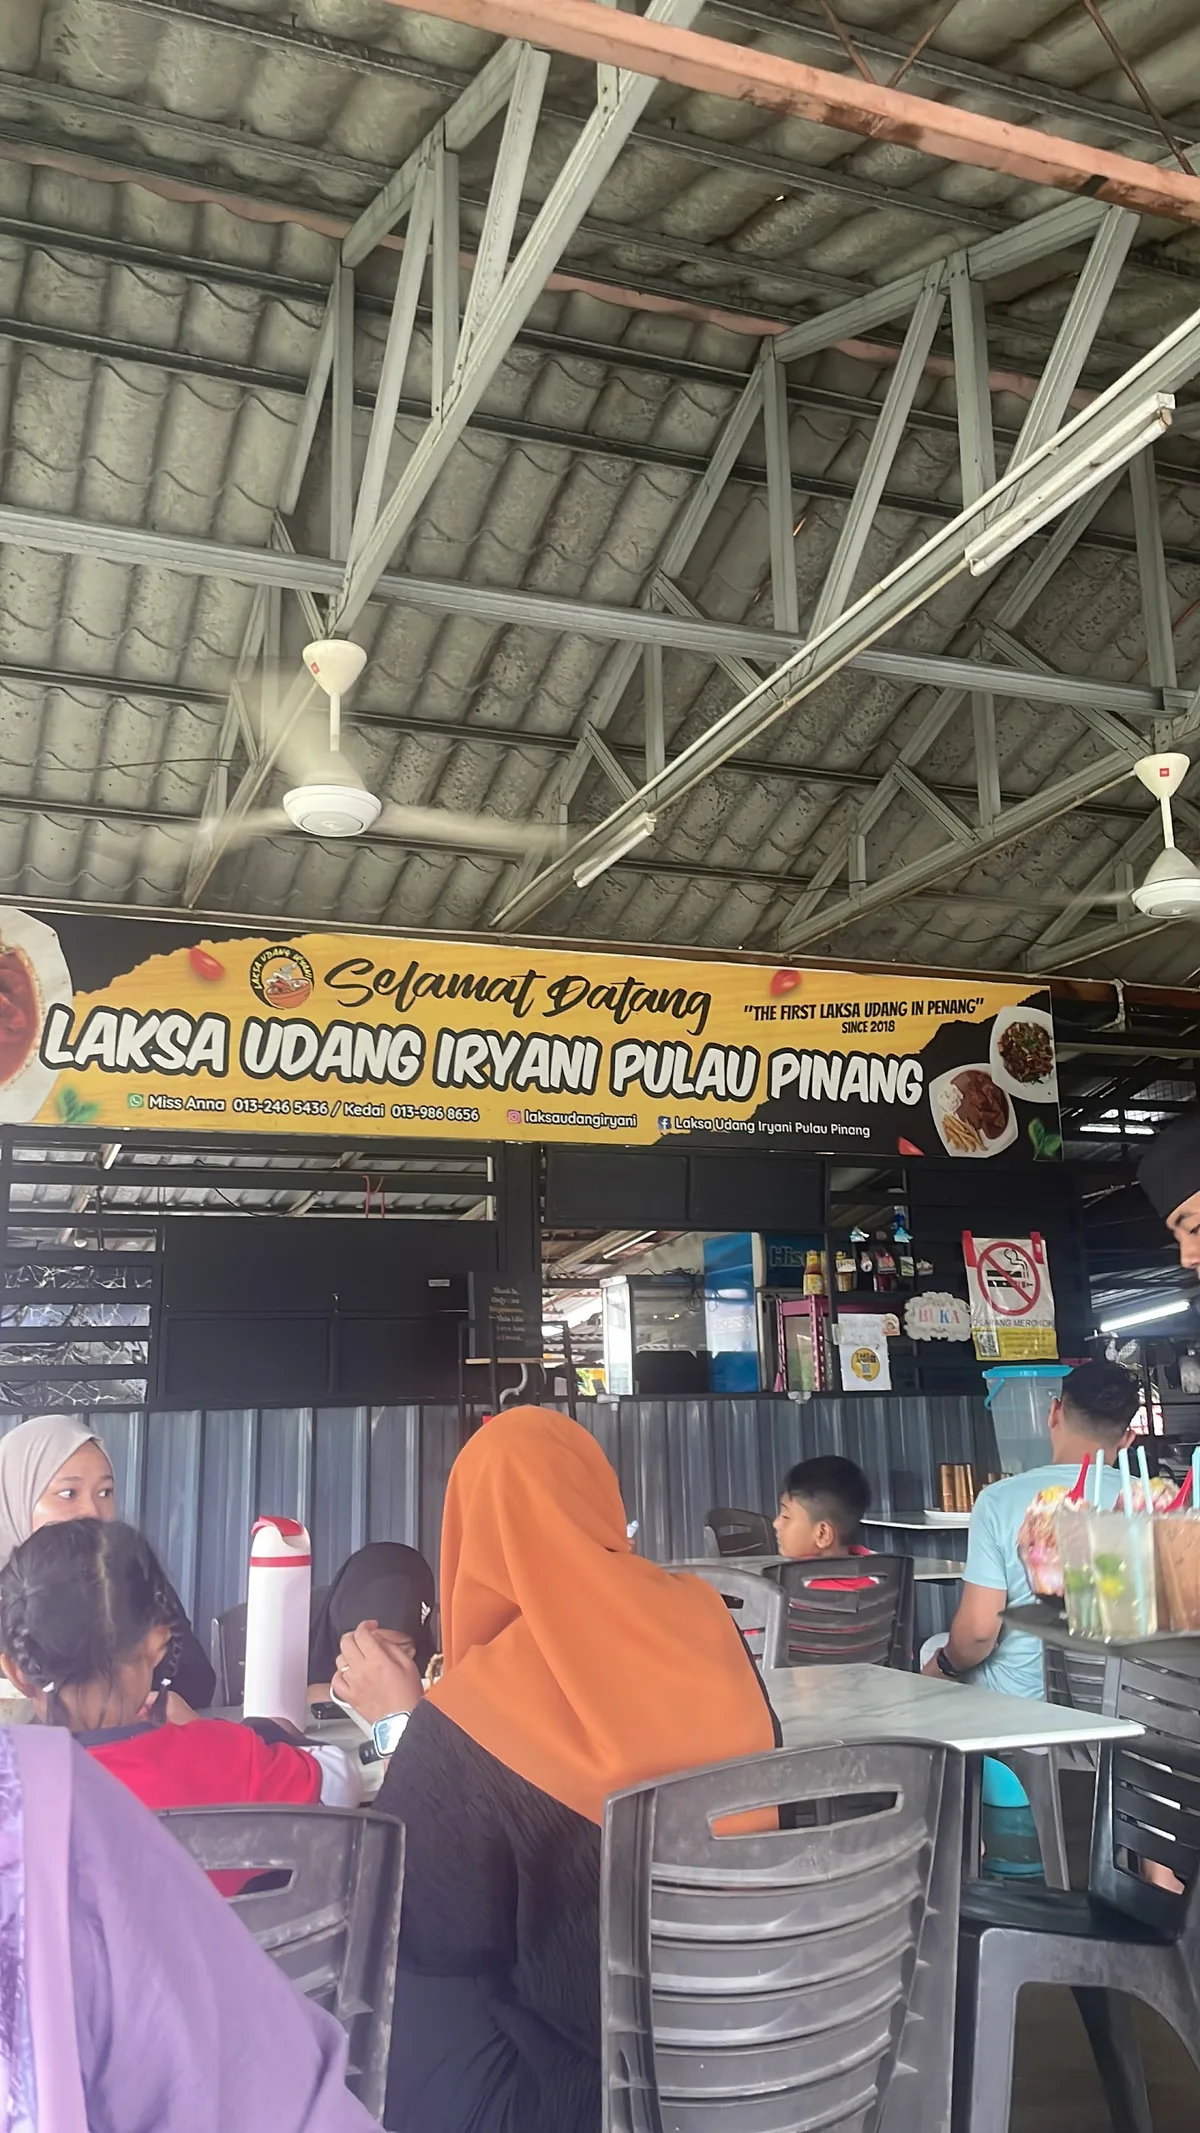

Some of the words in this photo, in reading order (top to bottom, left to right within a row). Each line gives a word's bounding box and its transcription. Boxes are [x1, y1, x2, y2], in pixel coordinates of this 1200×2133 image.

[251, 961, 263, 990] LAKSA
[260, 948, 291, 962] UDANG
[324, 957, 547, 1019] Selamat
[542, 974, 713, 1036] Datang
[780, 1004, 817, 1020] FIRST
[819, 1003, 861, 1019] LAKSA
[864, 1001, 908, 1018] UDANG
[911, 1000, 924, 1016] IN
[841, 1021, 869, 1034] SINCE
[870, 1020, 896, 1033] 2018
[42, 1007, 228, 1074] LAKSA
[242, 1019, 423, 1082] UDANG
[434, 1031, 600, 1092] IRYANI
[611, 1041, 759, 1099] PULAU
[768, 1050, 925, 1107] PINANG
[149, 1095, 182, 1110] Miss
[186, 1096, 225, 1111] Anna
[233, 1098, 290, 1114] 013-246
[293, 1102, 328, 1116] 5436
[344, 1103, 385, 1117] Kedai
[391, 1105, 444, 1119] 013-986
[447, 1108, 480, 1122] 8656
[525, 1109, 638, 1129] laksaudangiryani
[675, 1116, 713, 1130] Laksa
[714, 1119, 755, 1134] Udang
[758, 1121, 793, 1134] Iryani
[795, 1121, 828, 1135] Pulau
[831, 1123, 871, 1138] Pinang
[918, 1308, 961, 1324] BUKA
